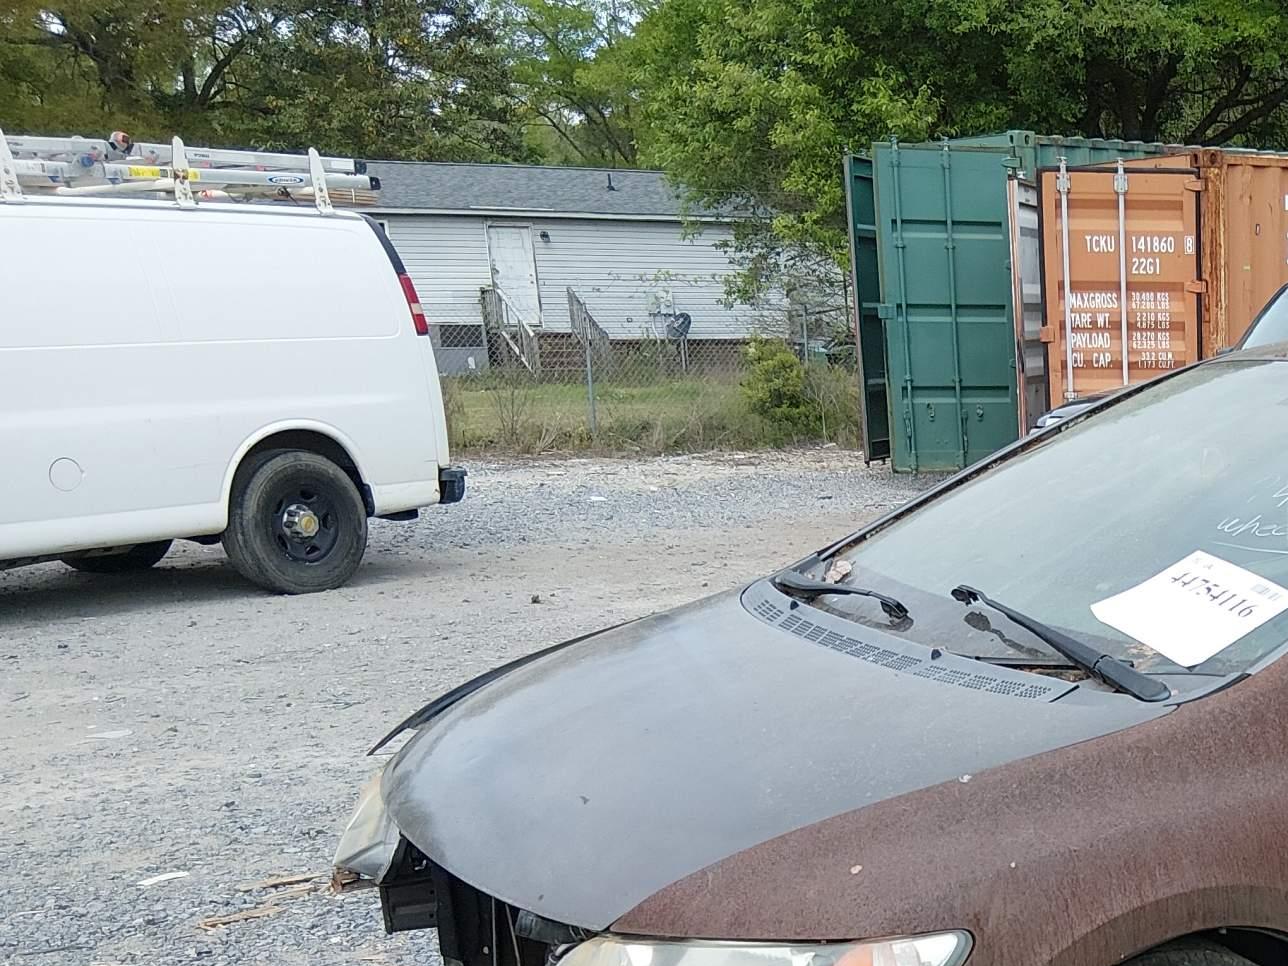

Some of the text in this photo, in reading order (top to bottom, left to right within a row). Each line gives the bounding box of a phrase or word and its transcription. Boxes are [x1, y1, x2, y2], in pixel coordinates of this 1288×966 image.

[1085, 235, 1115, 253] TCKU
[1131, 236, 1175, 253] 141860
[1131, 257, 1160, 275] 22G1
[1069, 292, 1118, 309] MAXGROSS
[1157, 291, 1169, 301] KGS
[1157, 301, 1170, 310] LBS
[1071, 313, 1112, 328] TARE WT.
[1158, 312, 1170, 321] KGS
[1158, 321, 1170, 329] LBS
[1071, 332, 1111, 349] PAYLOAD
[1158, 331, 1170, 341] KGS
[1158, 341, 1170, 349] LBS
[1072, 352, 1113, 368] CU. CAP.
